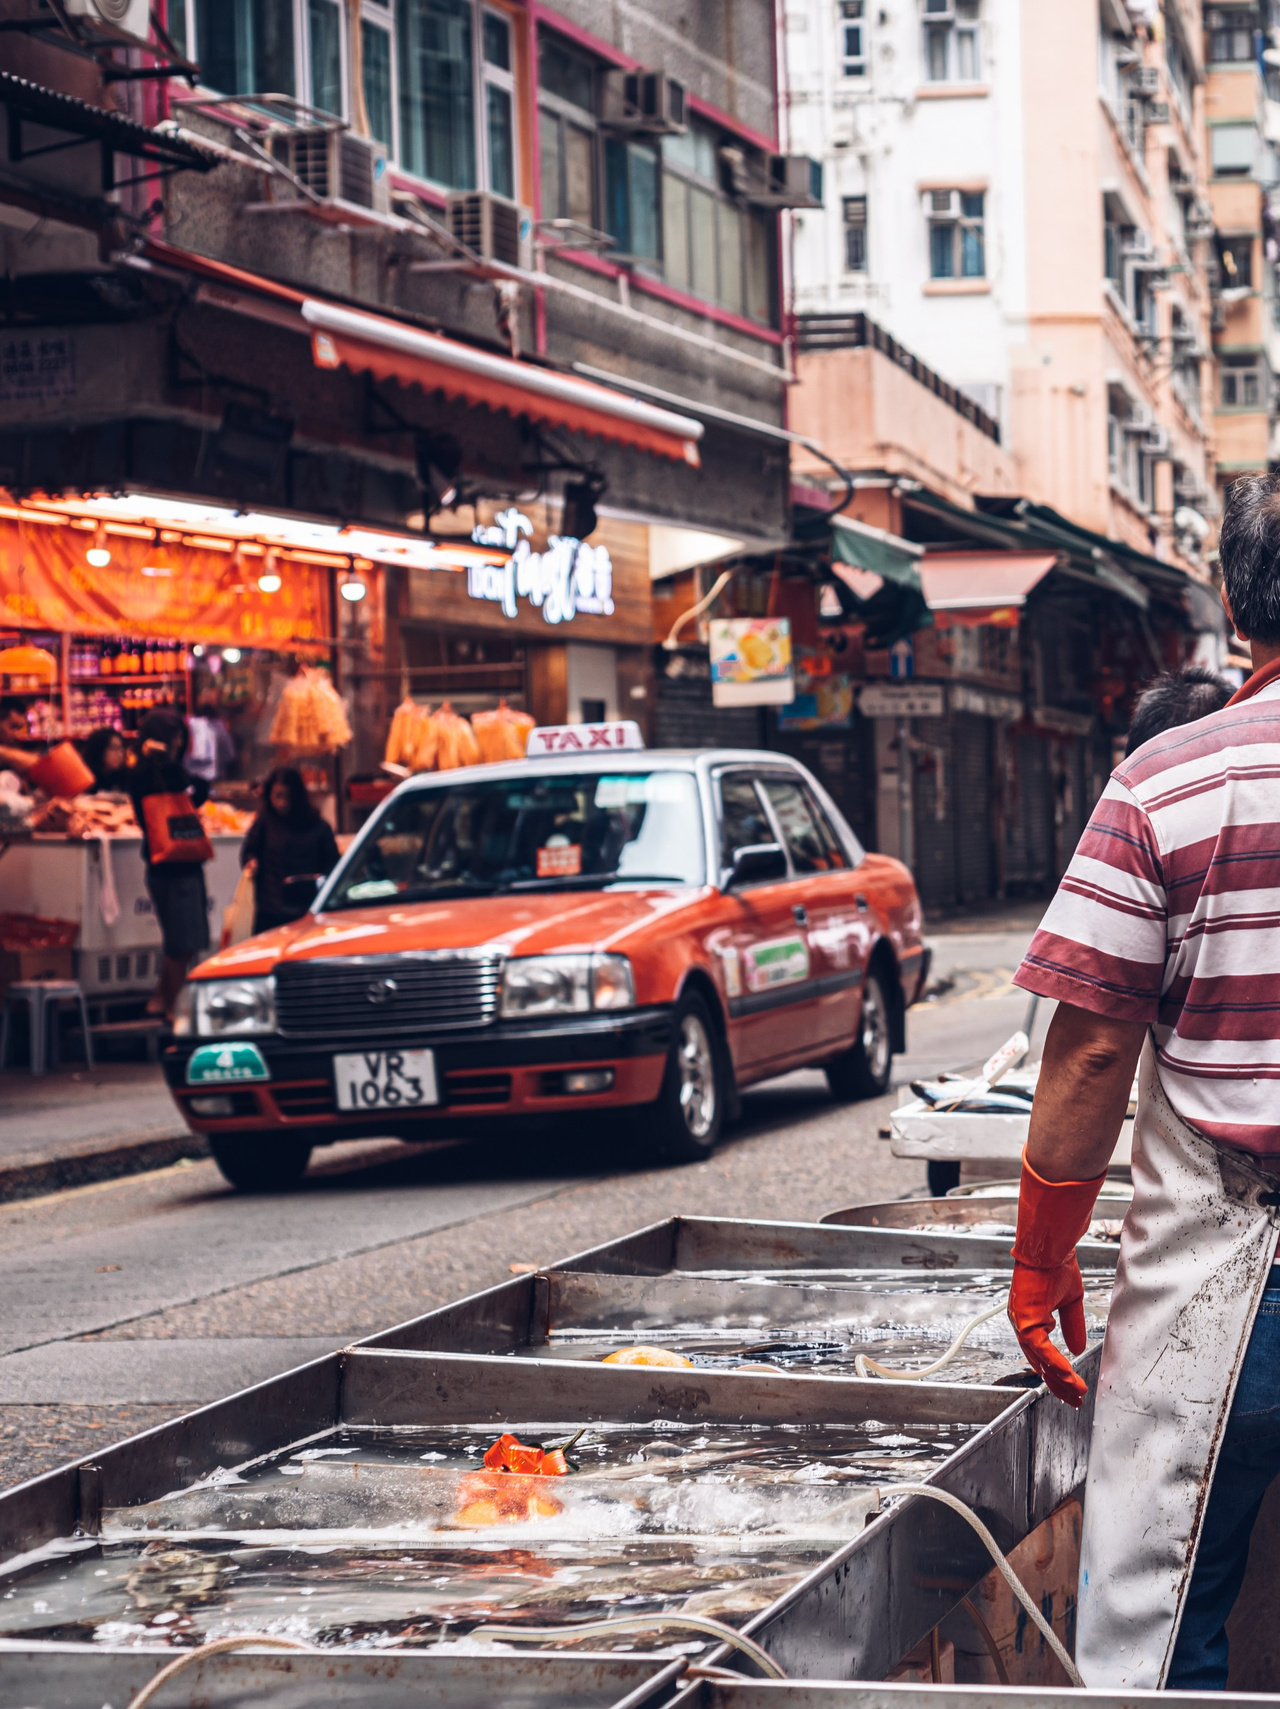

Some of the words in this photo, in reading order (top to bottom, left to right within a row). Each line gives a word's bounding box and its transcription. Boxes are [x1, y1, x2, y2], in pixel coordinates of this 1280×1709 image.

[538, 727, 626, 751] TAXI
[363, 1053, 405, 1080] VR
[349, 1077, 425, 1108] 1063
